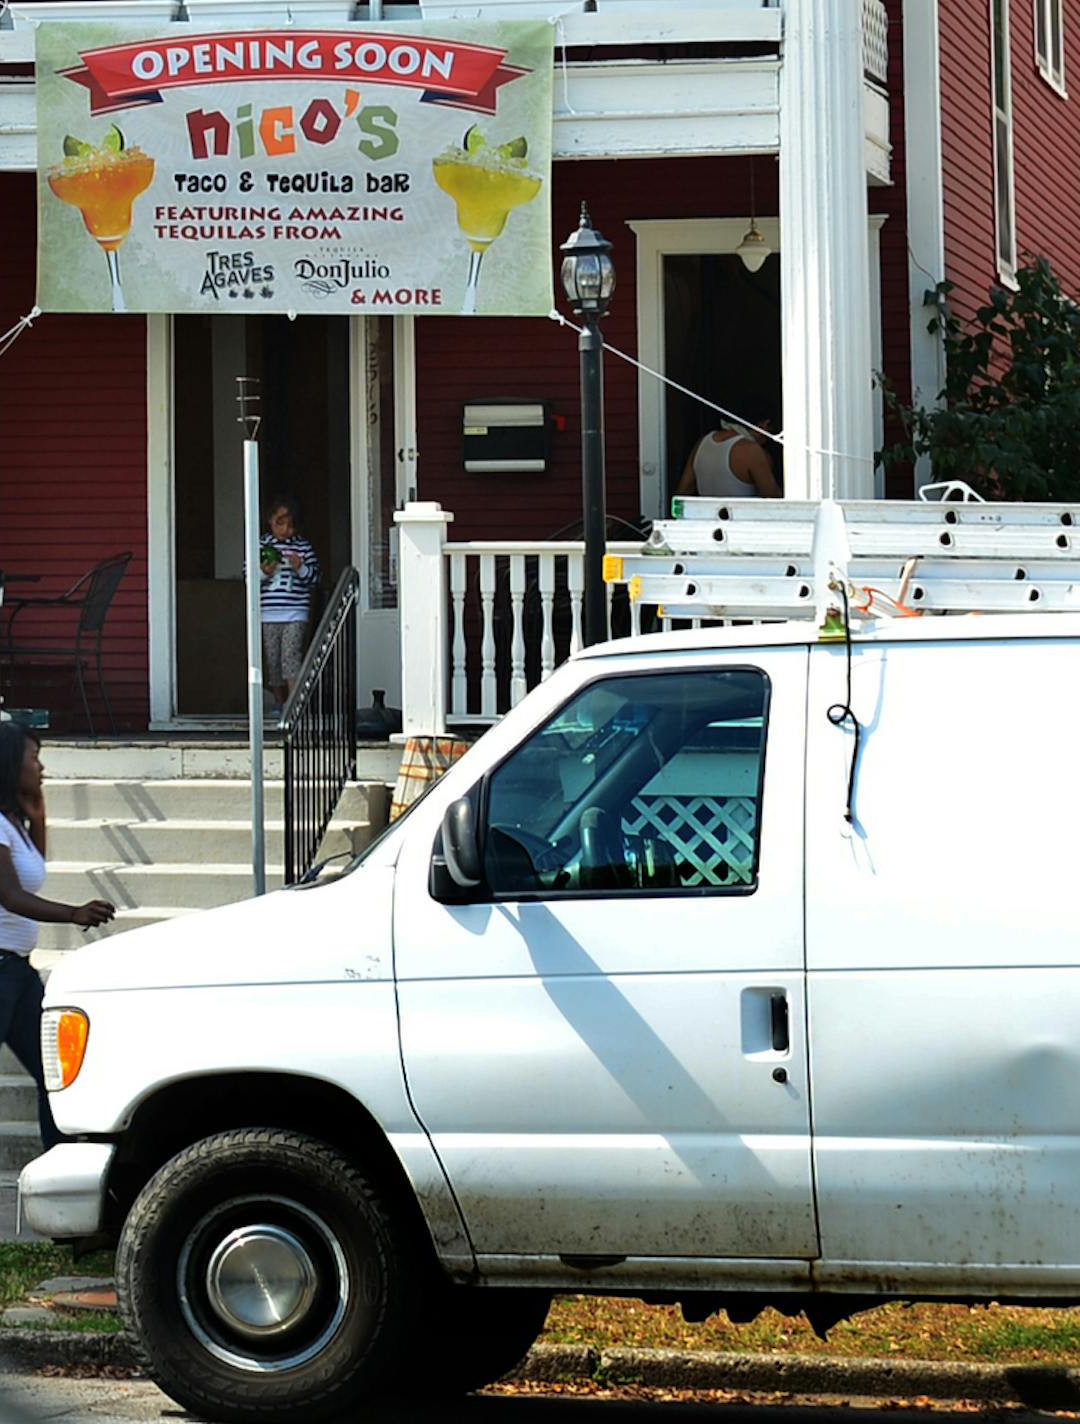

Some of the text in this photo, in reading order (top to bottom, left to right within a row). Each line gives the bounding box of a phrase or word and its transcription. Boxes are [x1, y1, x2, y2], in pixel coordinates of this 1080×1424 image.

[131, 39, 456, 80] OPENING SOON
[186, 89, 400, 161] nico's
[239, 171, 254, 193] &
[155, 206, 404, 221] FEATURING AMAZING
[153, 225, 342, 240] TEQUILAS FROM
[206, 251, 255, 275] TRES
[200, 265, 274, 299] AGAVES
[350, 288, 441, 305] & MORE
